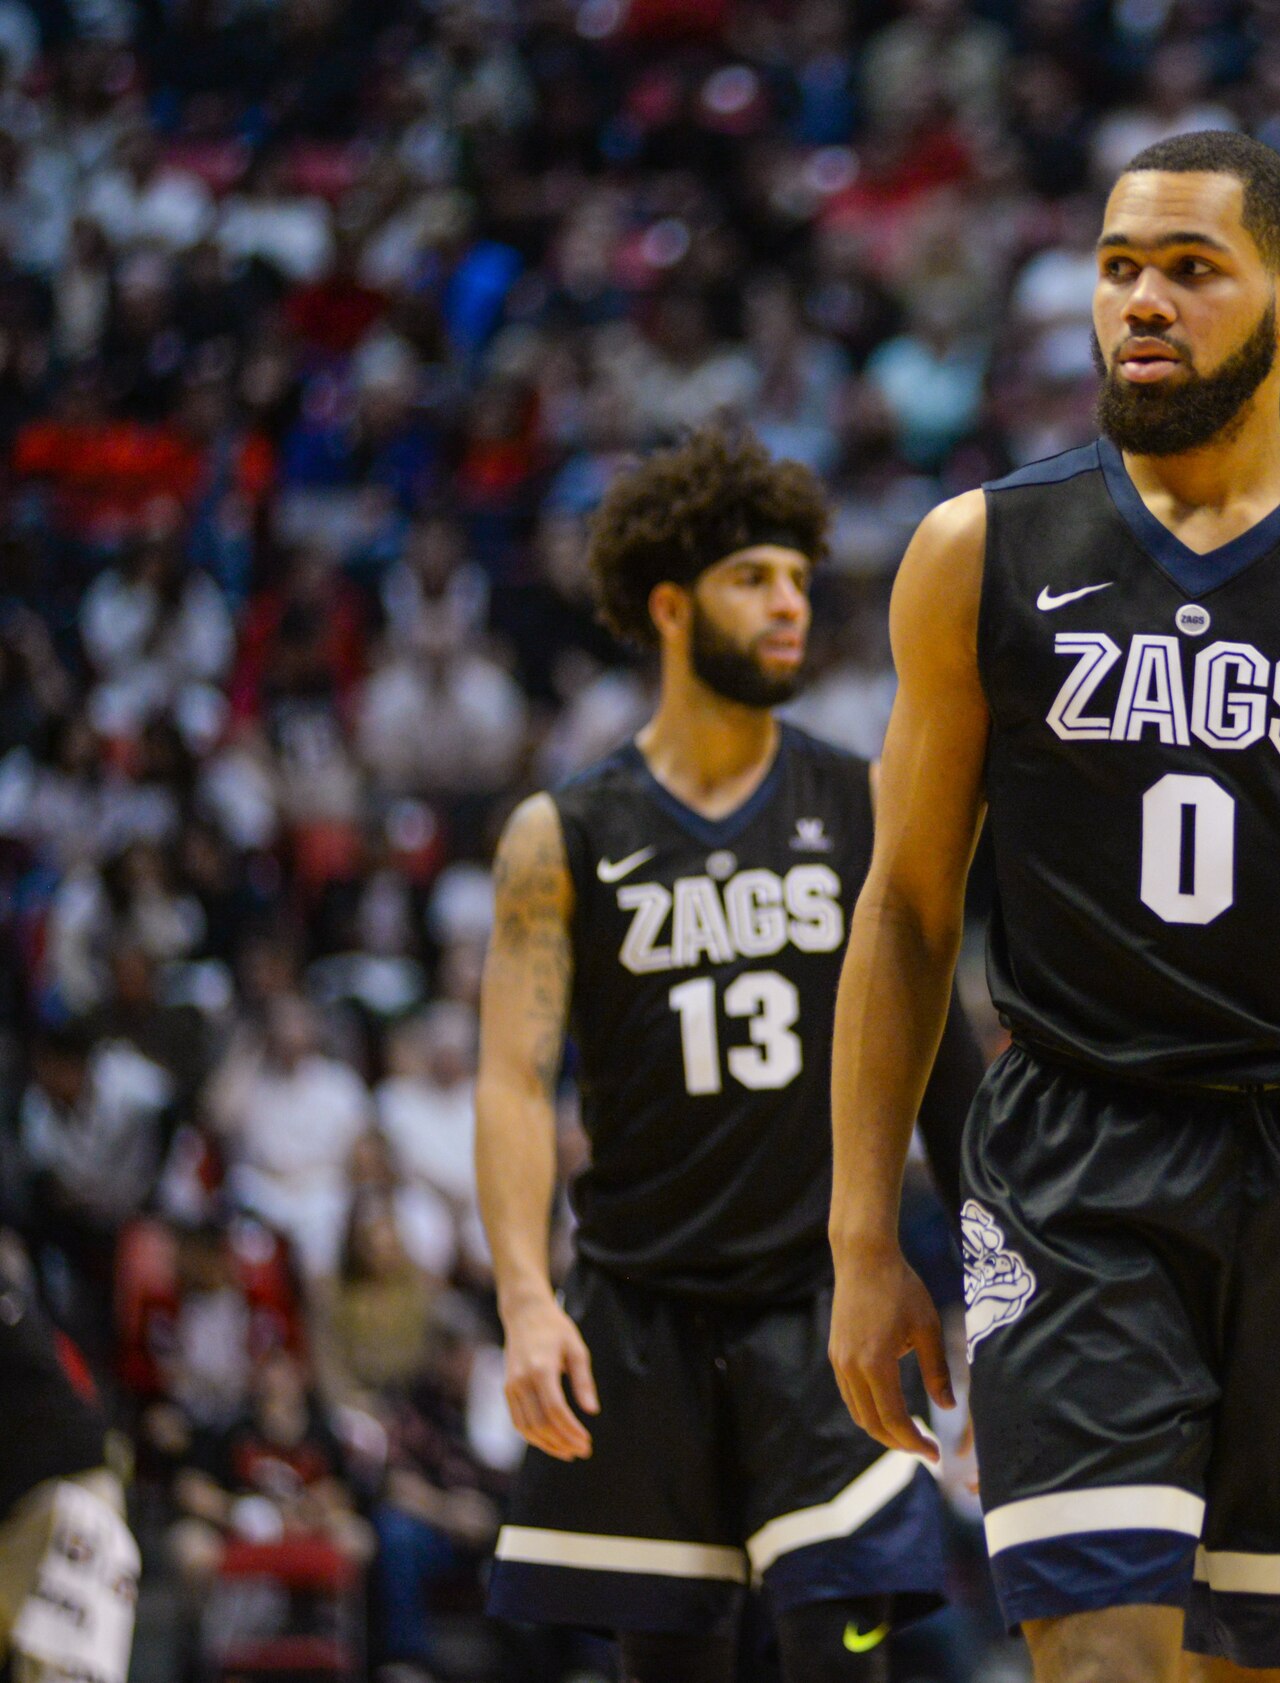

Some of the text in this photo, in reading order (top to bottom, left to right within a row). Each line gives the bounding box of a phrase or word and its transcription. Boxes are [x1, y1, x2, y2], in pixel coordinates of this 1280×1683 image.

[1180, 614, 1205, 625] ZAGS
[1140, 773, 1235, 925] 0
[616, 864, 844, 974] ZAGS
[669, 970, 803, 1096] 13
